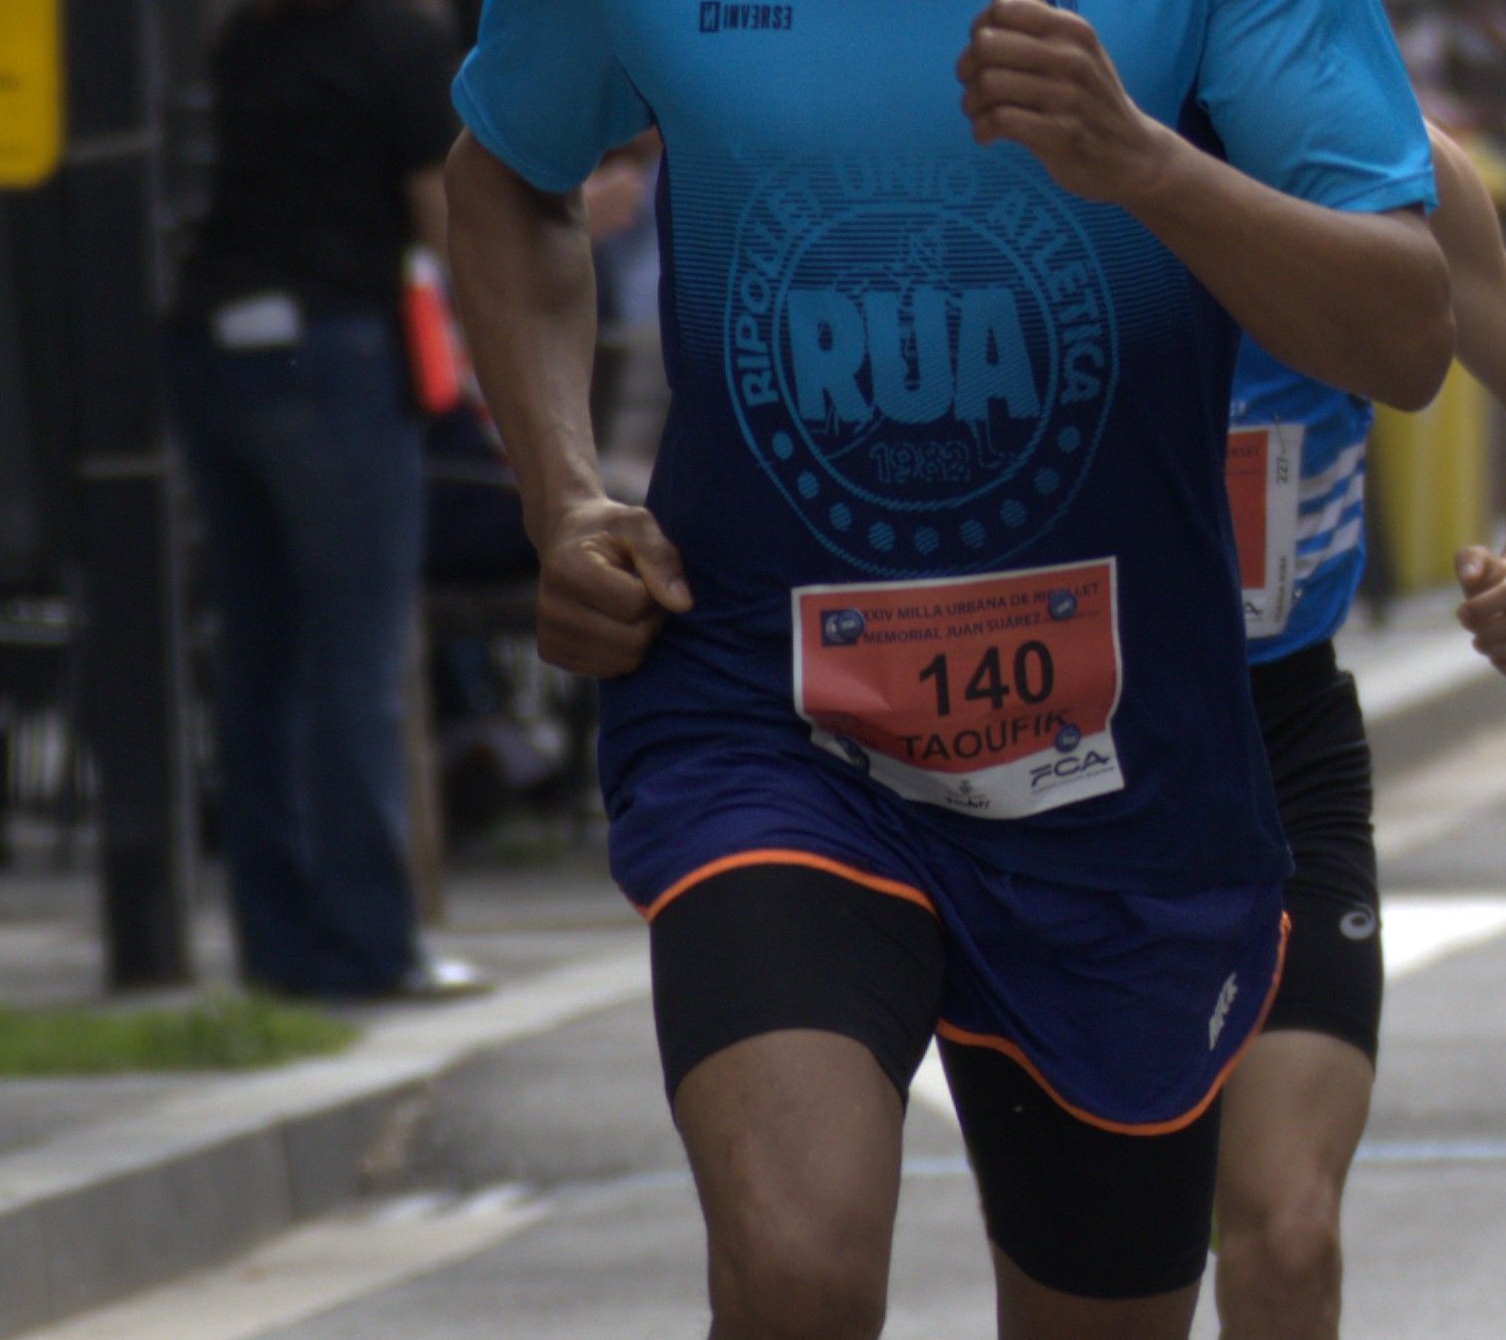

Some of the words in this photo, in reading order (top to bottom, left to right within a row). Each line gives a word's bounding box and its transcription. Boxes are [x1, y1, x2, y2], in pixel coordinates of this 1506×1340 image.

[786, 285, 1042, 425] RUA
[1275, 458, 1290, 484] 227
[897, 603, 943, 620] MILLA
[947, 595, 1008, 616] URBANA
[1009, 594, 1030, 607] DE
[863, 627, 942, 645] MEMORIAL
[945, 623, 984, 638] JUAN
[918, 640, 1055, 718] 140
